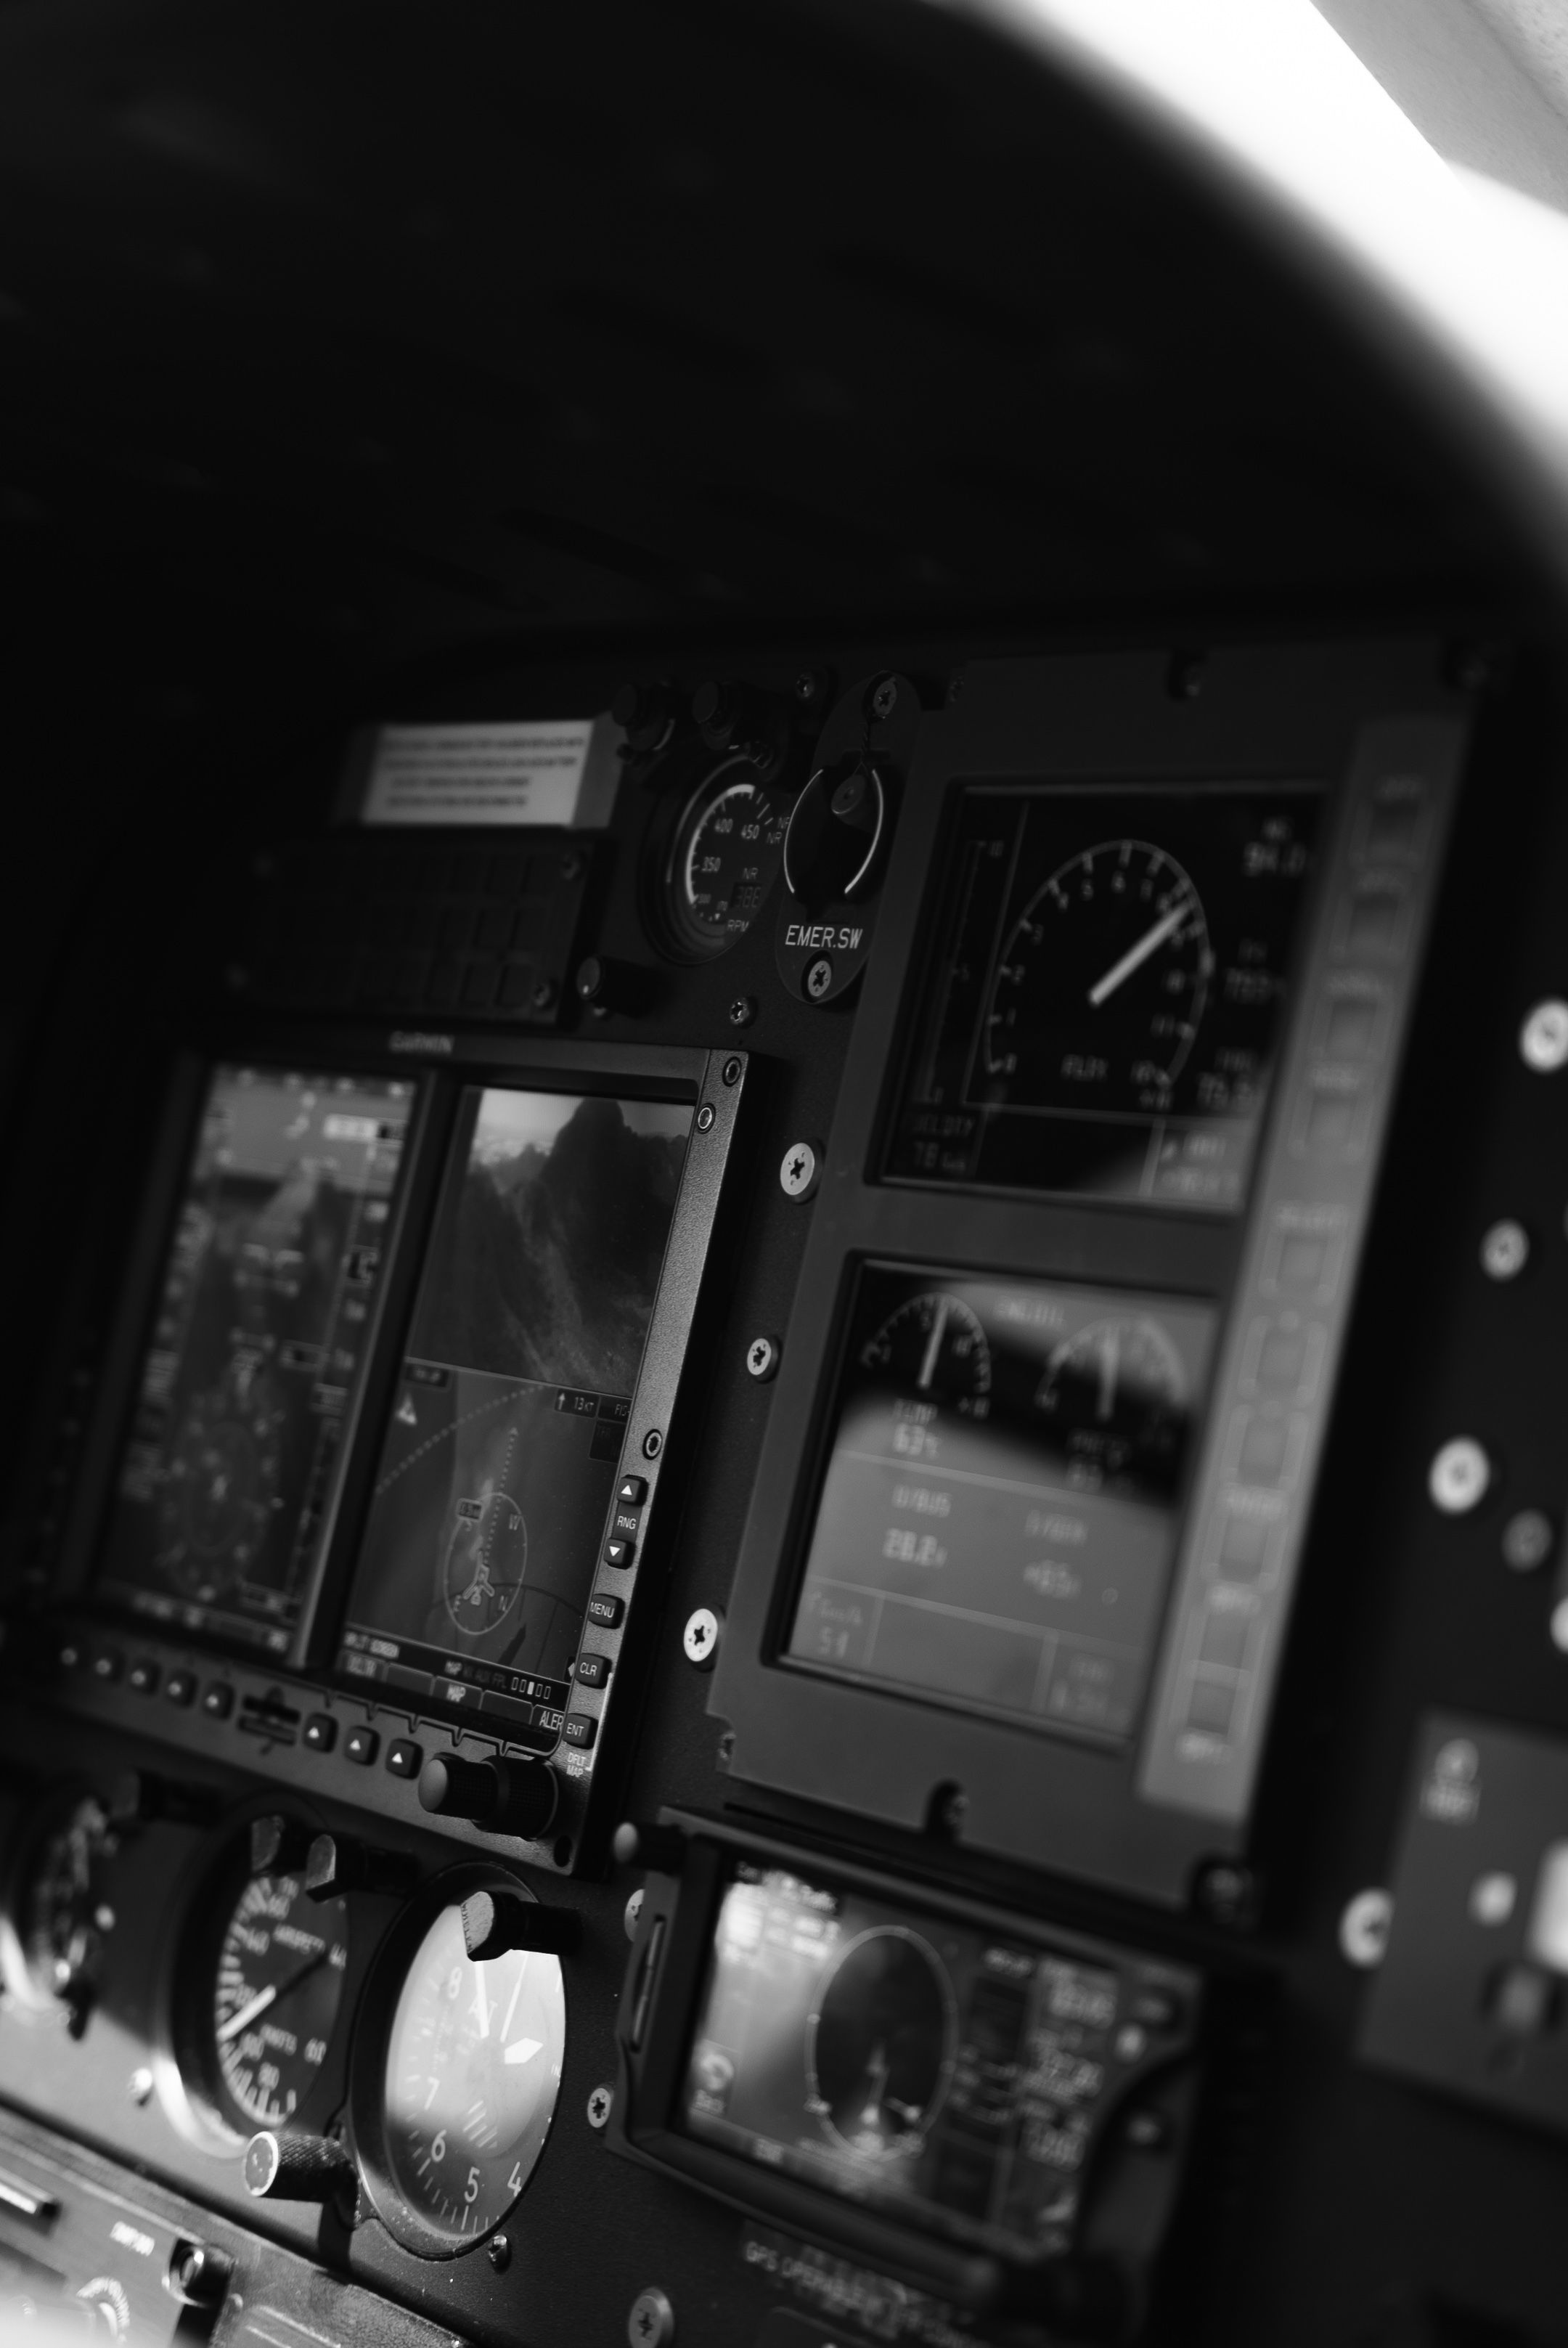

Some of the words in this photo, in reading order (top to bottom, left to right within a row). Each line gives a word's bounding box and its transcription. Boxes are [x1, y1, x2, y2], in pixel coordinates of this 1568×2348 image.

[740, 823, 761, 841] 450
[766, 831, 783, 845] NR
[701, 855, 722, 873] 350
[742, 867, 759, 881] NR
[727, 918, 750, 934] RPM
[785, 924, 864, 950] EMER.SW
[617, 1515, 637, 1530] RNG
[590, 1602, 616, 1618] MENU
[580, 1662, 597, 1676] CLR
[566, 1723, 584, 1737] ENT
[568, 1751, 587, 1767] DFLT
[448, 1966, 462, 2000] 8
[425, 2076, 441, 2111] 7
[431, 2129, 447, 2162] 6
[465, 2166, 481, 2203] 5
[507, 2161, 522, 2197] 4
